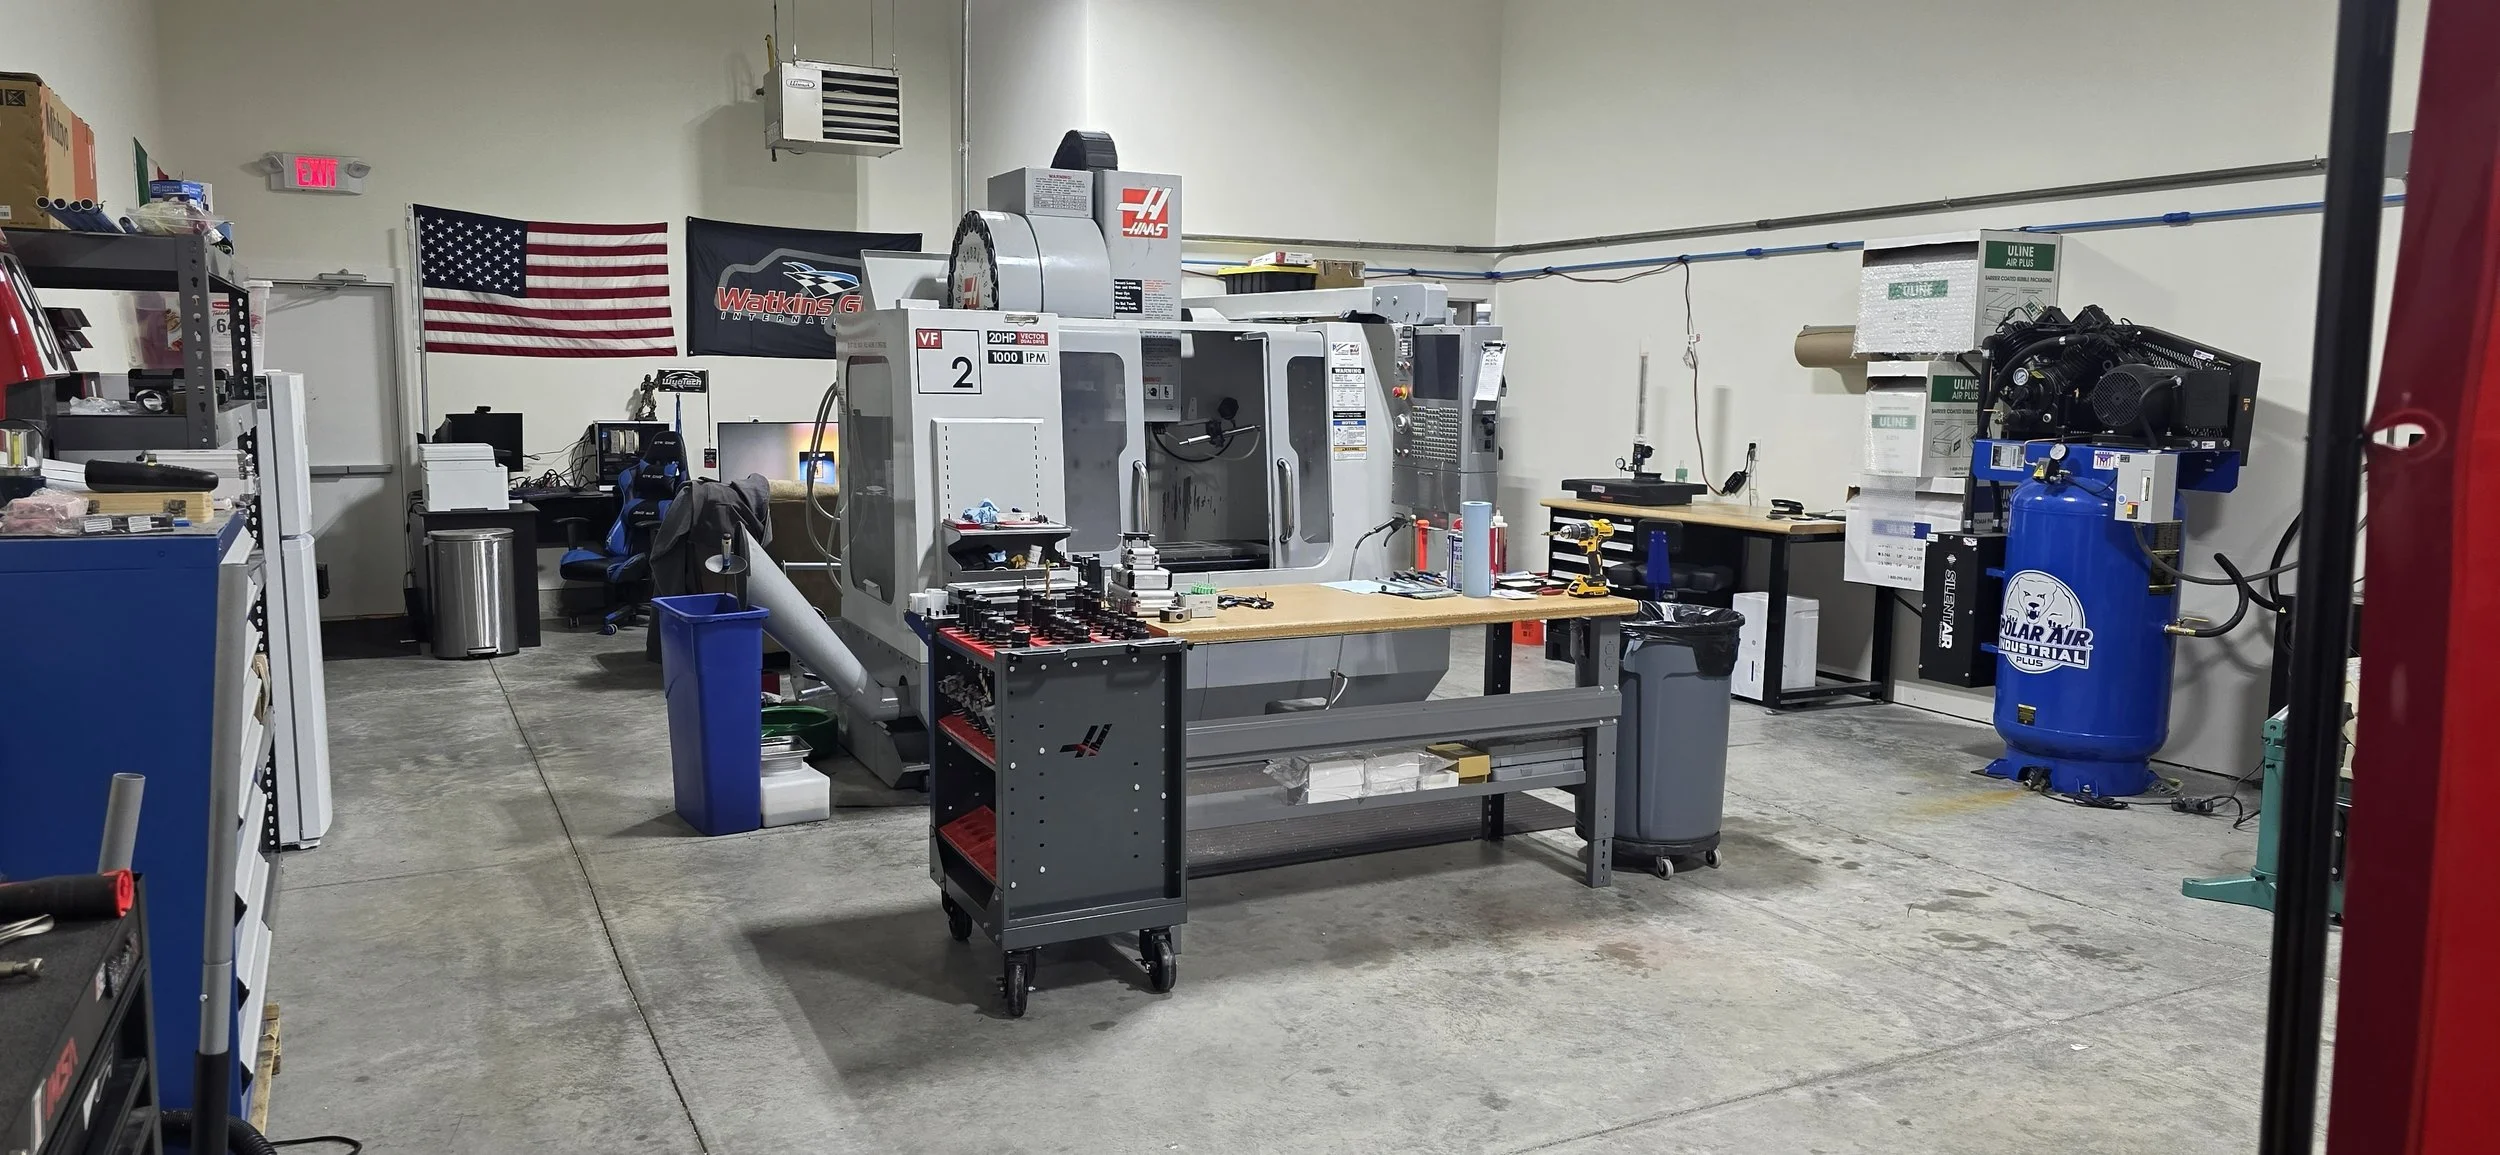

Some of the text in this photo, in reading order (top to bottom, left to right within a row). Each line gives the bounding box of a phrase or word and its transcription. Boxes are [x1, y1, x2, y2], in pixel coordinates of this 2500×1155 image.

[295, 156, 338, 188] EXIT
[1122, 222, 1169, 236] HAAS
[2007, 245, 2035, 257] ULINE
[2006, 258, 2034, 267] AIR PLUS
[717, 287, 834, 316] Watkins
[720, 311, 837, 325] INTERNAT
[919, 332, 938, 346] VF
[988, 332, 1017, 344] 20HP
[992, 352, 1047, 363] 1000 IPM
[951, 356, 974, 388] 2
[1953, 379, 1979, 390] ULINE
[1952, 391, 1979, 400] AIR PLUS
[1879, 416, 1908, 427] ULINE
[2000, 618, 2091, 647] POLAR AIR
[2000, 638, 2085, 665] NDUSTRIAL
[2016, 656, 2043, 667] PLUS
